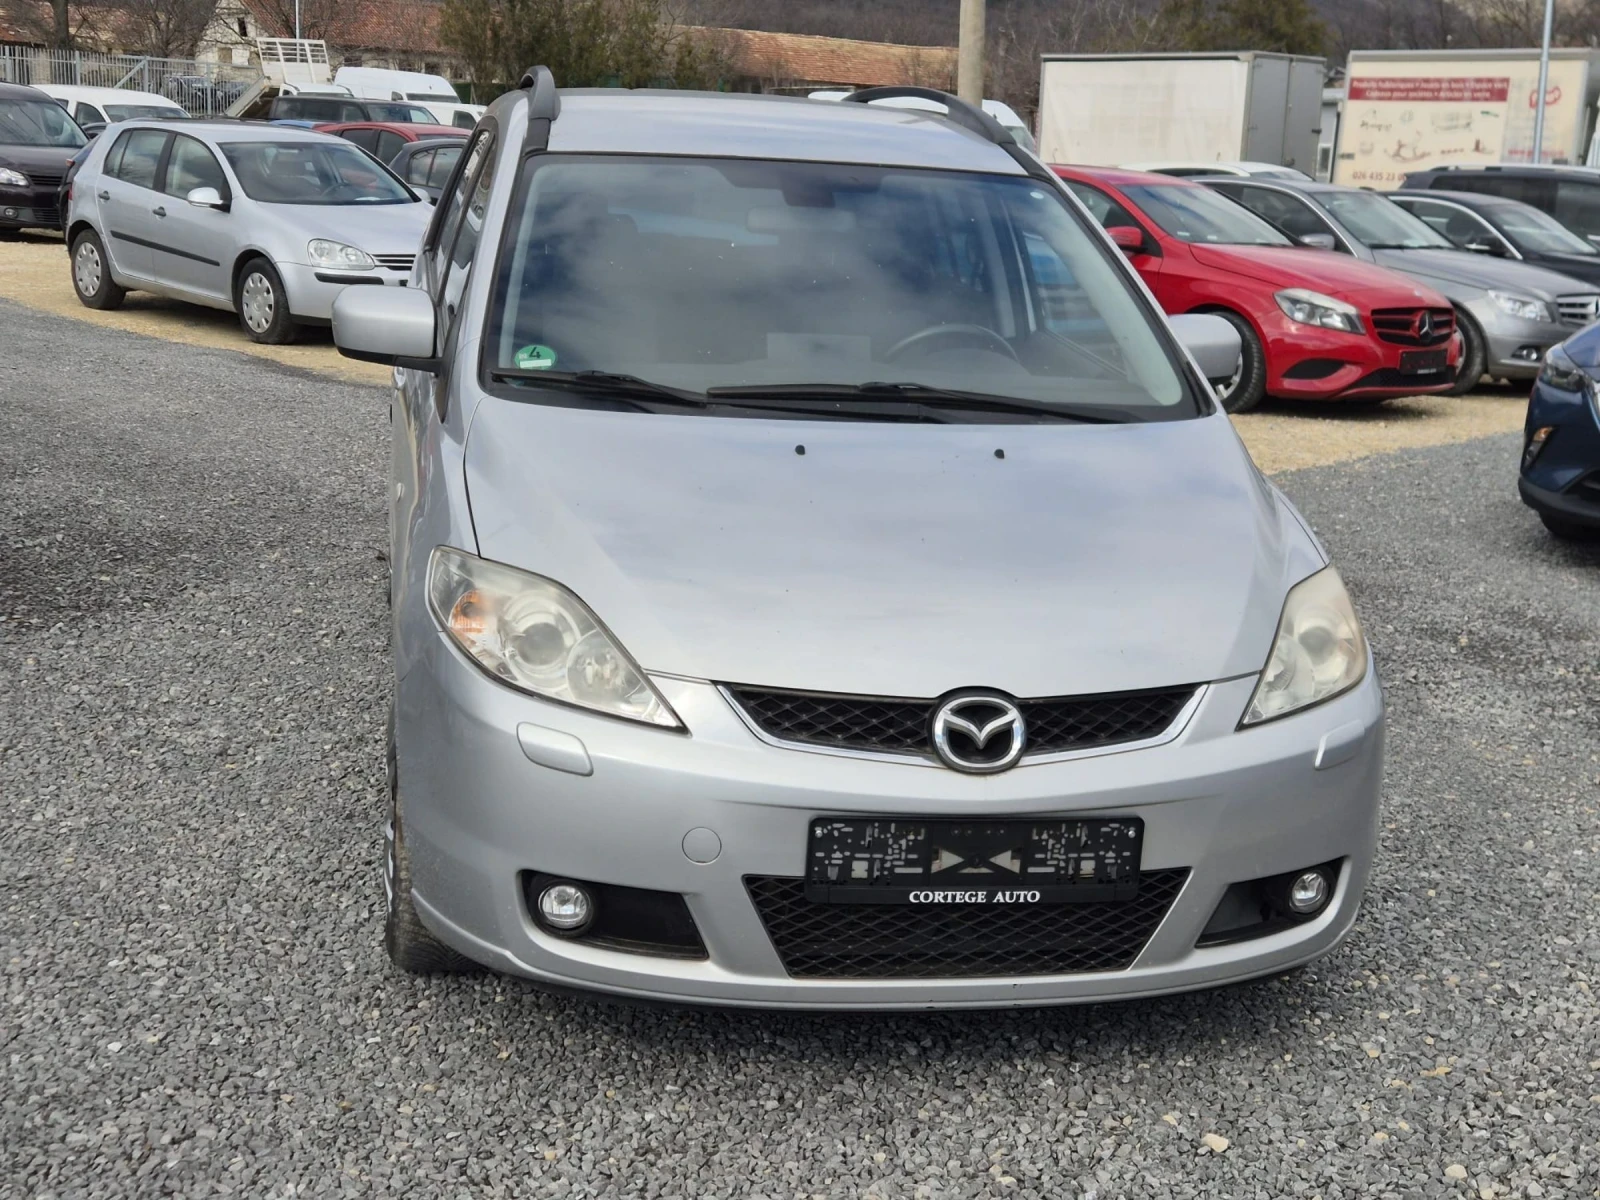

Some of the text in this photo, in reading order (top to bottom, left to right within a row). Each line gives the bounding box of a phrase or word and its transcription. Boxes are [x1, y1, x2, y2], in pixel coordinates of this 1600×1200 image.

[1352, 171, 1367, 180] 026
[1369, 171, 1383, 181] 435
[529, 346, 541, 359] 4
[908, 890, 1041, 903] CORTEGE AUTO
